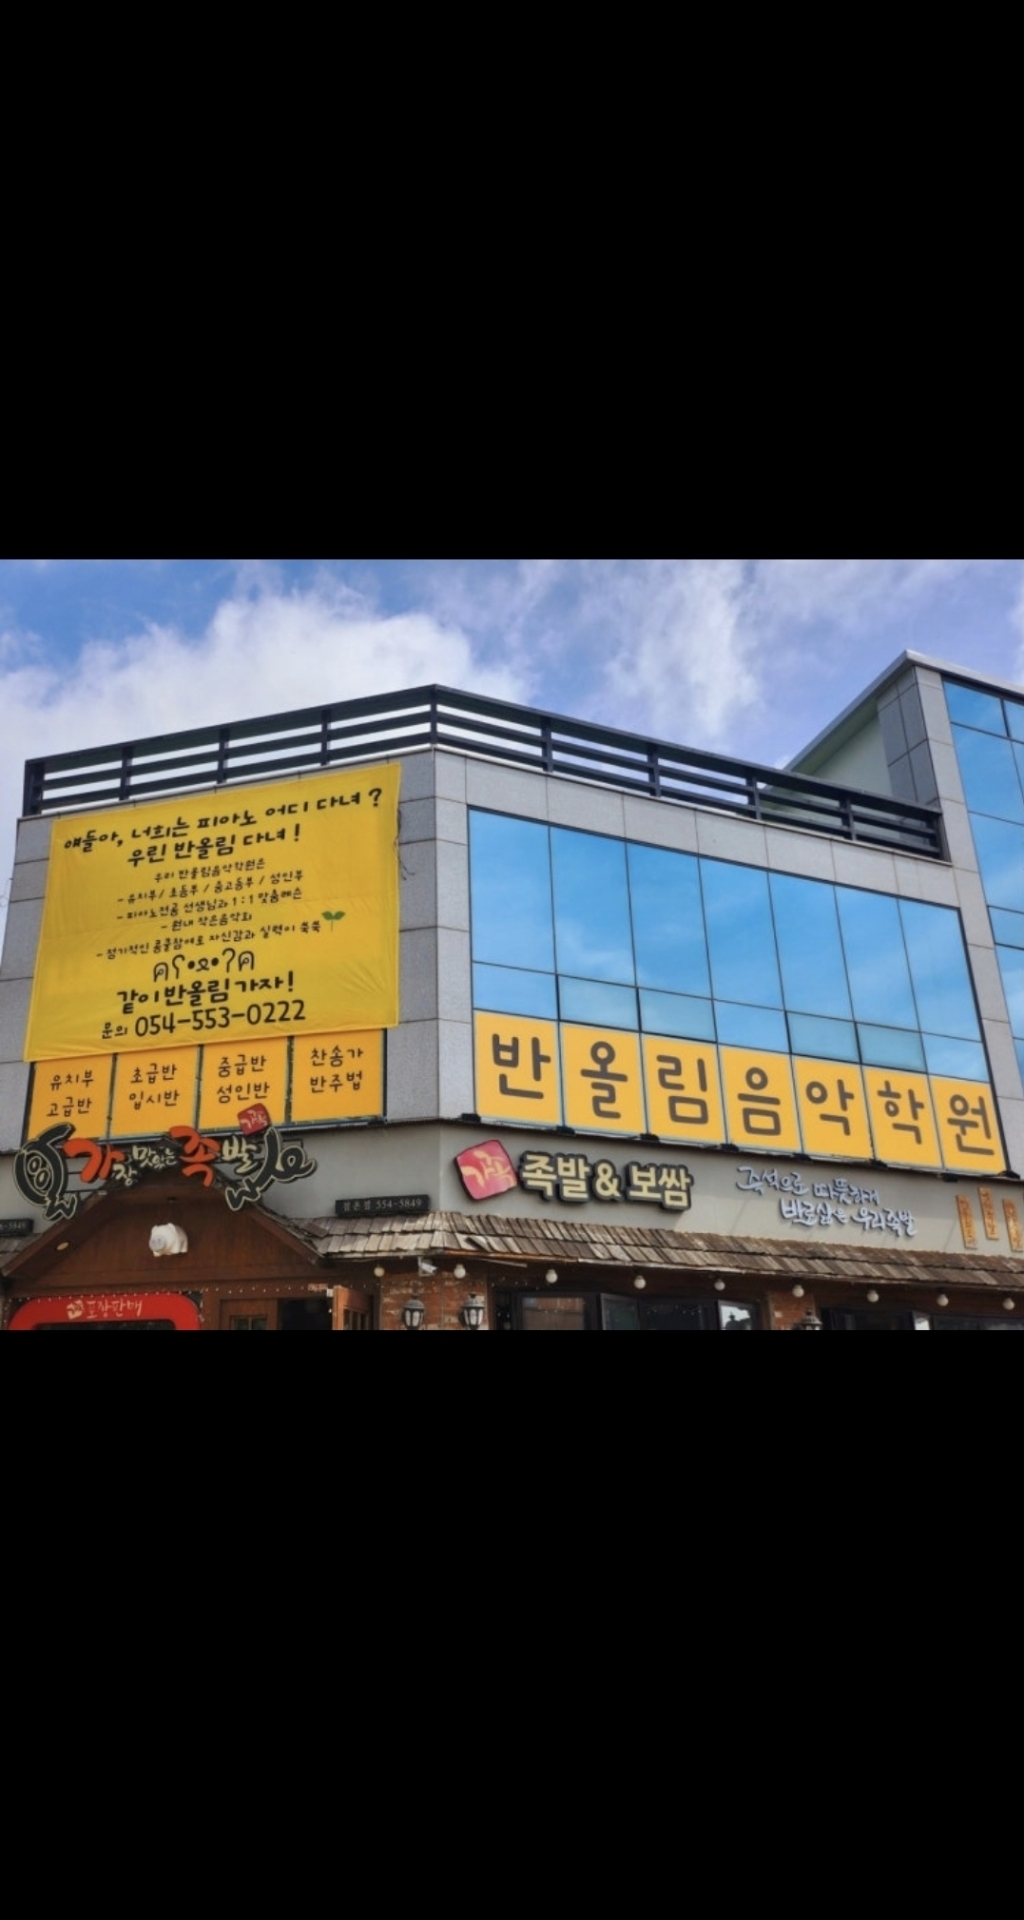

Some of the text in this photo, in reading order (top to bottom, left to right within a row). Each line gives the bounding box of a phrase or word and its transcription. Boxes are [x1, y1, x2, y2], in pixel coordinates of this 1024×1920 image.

[131, 816, 190, 840] 너희는
[196, 810, 257, 829] 피아노
[265, 801, 309, 817] 어디
[316, 791, 361, 810] 다녀
[127, 843, 167, 867] 우린
[174, 835, 236, 860] 반올림
[154, 858, 265, 883] 우리 반올림음악학원은
[169, 884, 198, 898] 초등부
[214, 876, 254, 894] 중고등부
[270, 869, 304, 885] 성인부
[184, 898, 228, 913] 선생님과
[257, 886, 302, 904] 맞춤레슨
[171, 919, 194, 932] 원내
[107, 942, 149, 960] 정기적인
[209, 929, 255, 943] 자신감과
[259, 924, 295, 939] 실력이
[101, 999, 306, 1040] 문의 054-553-0222
[218, 1054, 267, 1078] 중급반
[310, 1044, 364, 1068] 찬송가
[50, 1069, 94, 1092] 유치부
[130, 1062, 178, 1085] 초급반
[309, 1070, 363, 1094] 반주법
[129, 1089, 180, 1111] 입시반
[216, 1081, 270, 1104] 성인반
[46, 1096, 92, 1118] 고급반
[131, 1144, 178, 1171] 맛있는
[168, 1124, 258, 1188] 족발
[626, 1163, 692, 1208] 보쌈
[736, 1166, 810, 1195] 즉석으로
[86, 1298, 143, 1319] 포장판매
